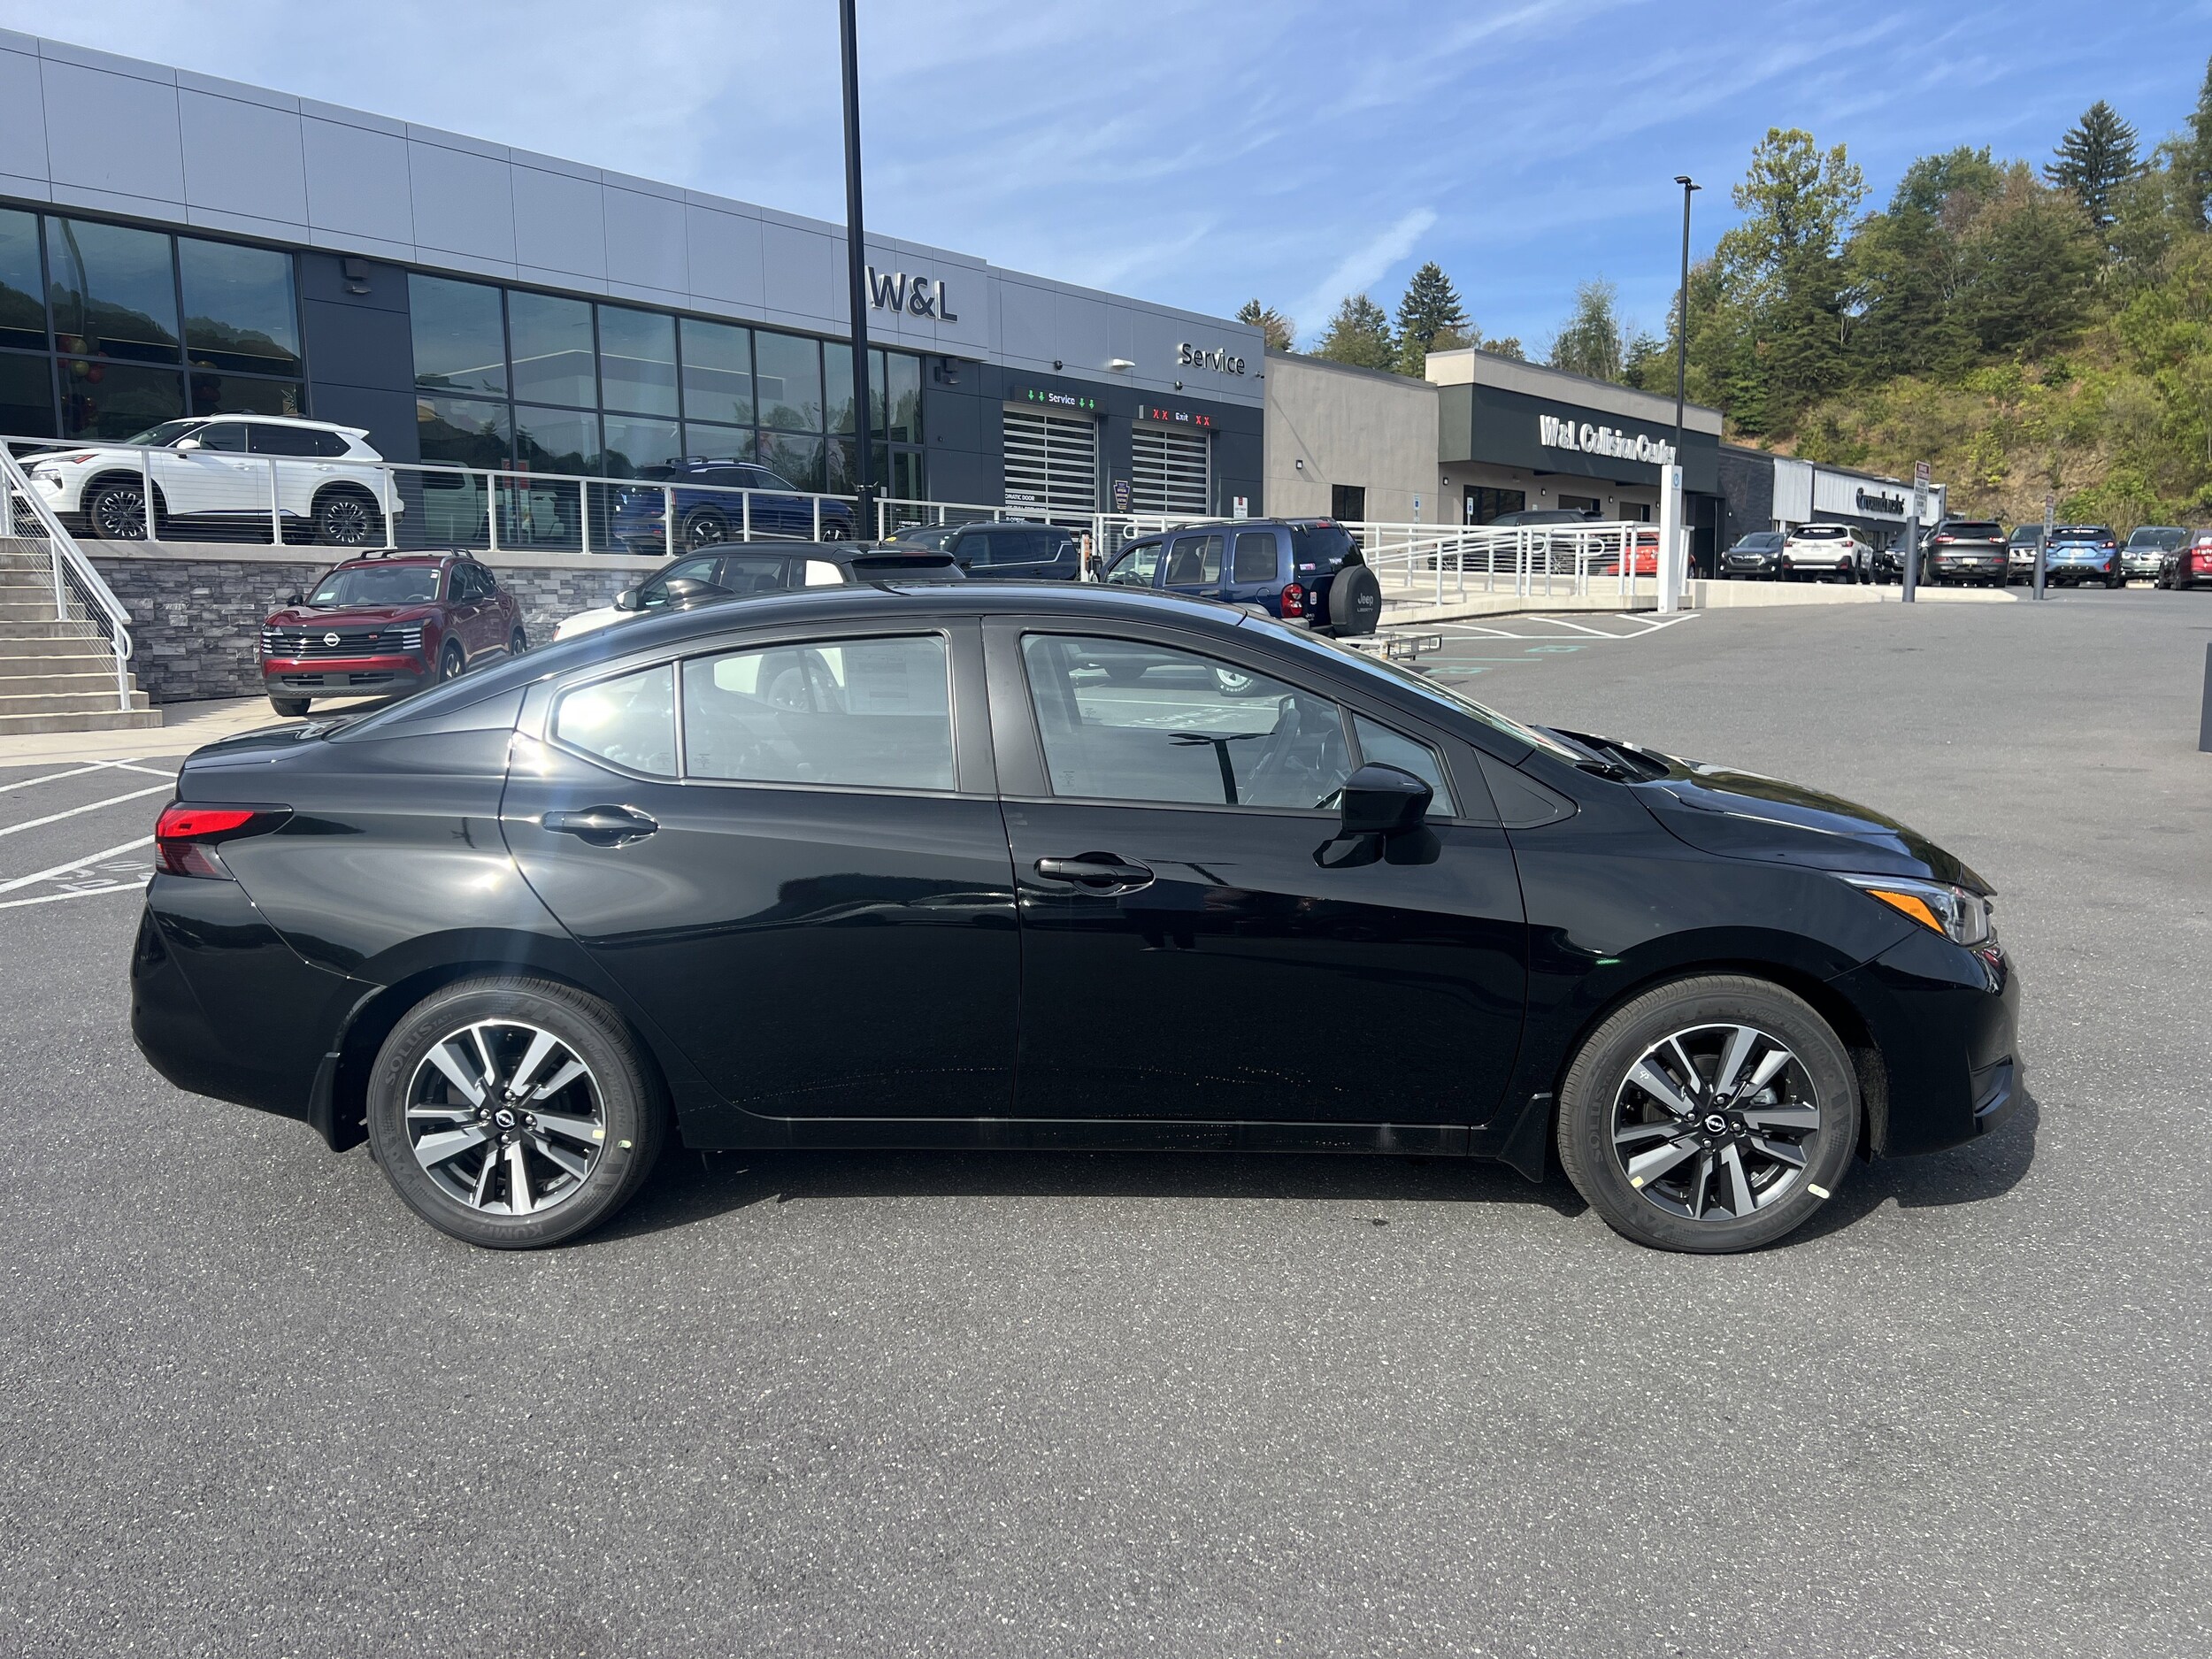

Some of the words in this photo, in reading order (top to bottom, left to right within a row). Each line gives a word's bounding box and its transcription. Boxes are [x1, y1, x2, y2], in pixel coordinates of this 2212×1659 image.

[864, 265, 958, 322] W&L
[1178, 342, 1246, 376] Service
[1048, 393, 1076, 405] Service
[1175, 412, 1189, 422] Exit
[1540, 414, 1580, 451] W&L
[1579, 423, 1638, 461] Collision
[1637, 434, 1677, 465] Center
[1357, 592, 1374, 607] Jeep
[385, 1022, 433, 1086] SOLUS
[1589, 1086, 1607, 1163] SOLUS
